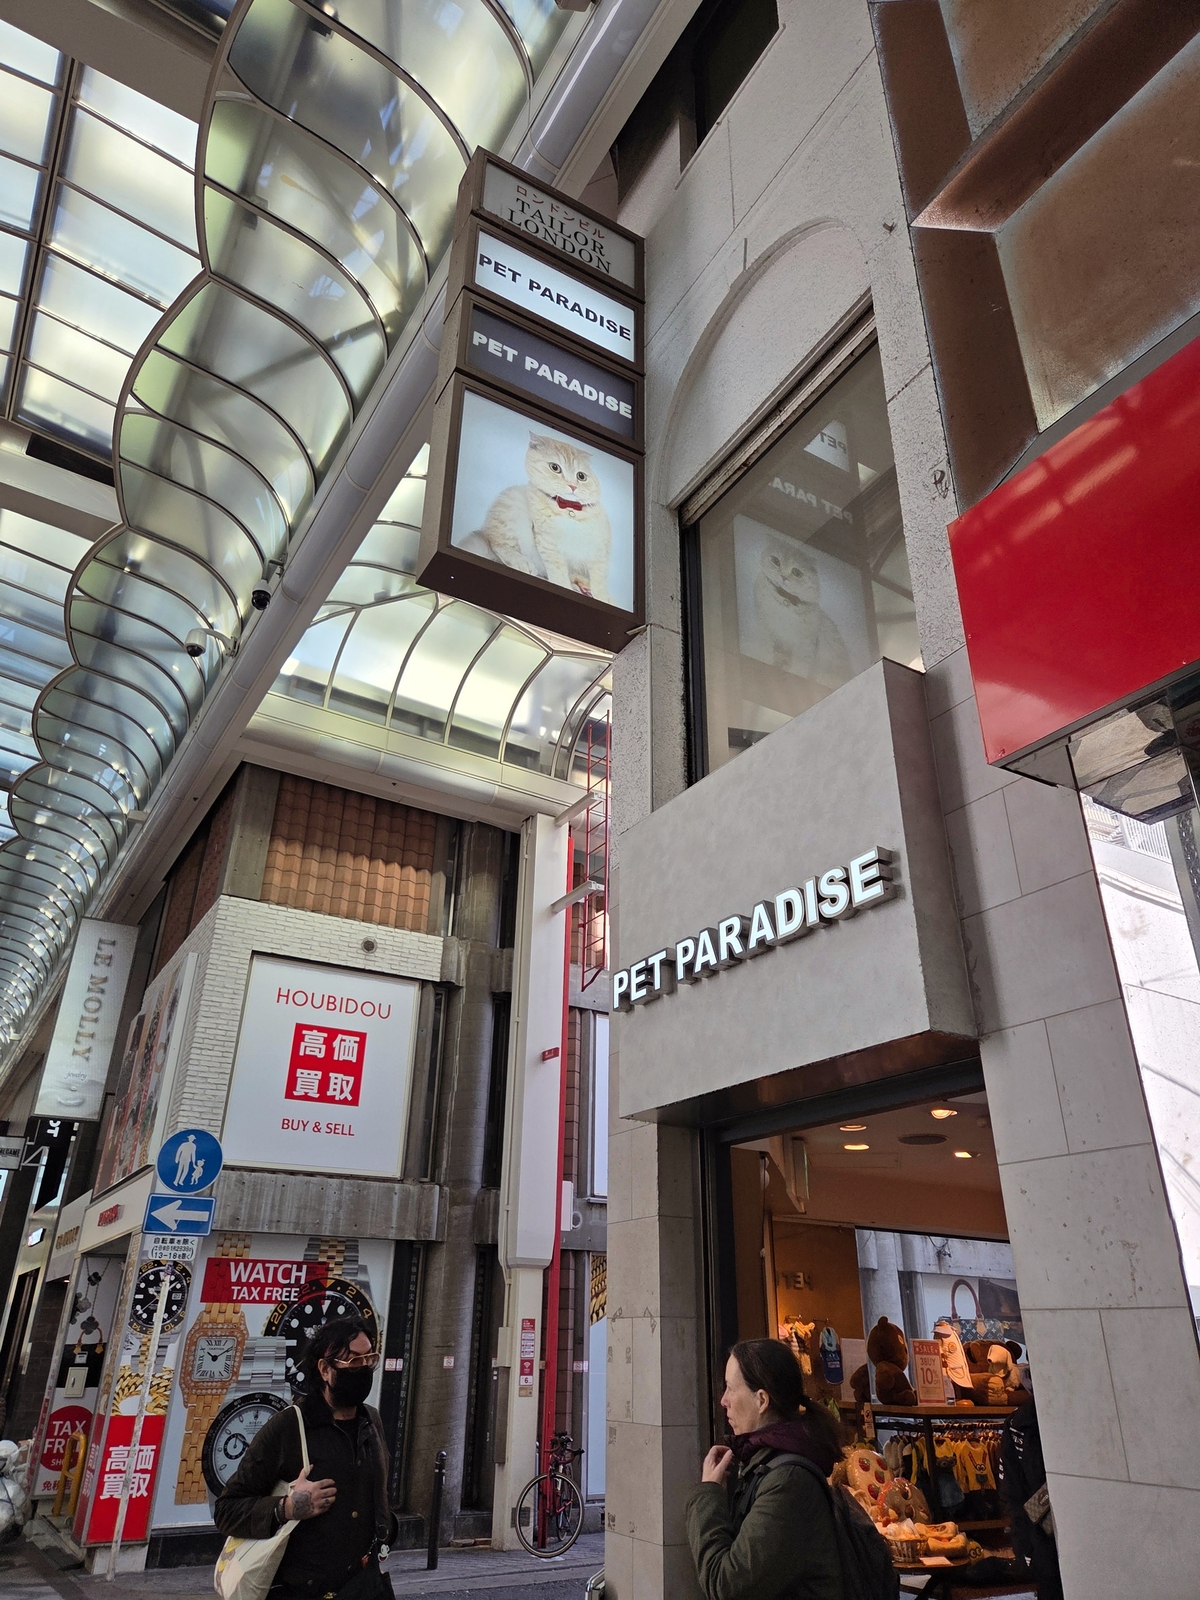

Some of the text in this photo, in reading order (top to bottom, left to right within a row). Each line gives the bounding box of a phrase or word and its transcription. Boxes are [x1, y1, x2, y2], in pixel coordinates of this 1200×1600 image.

[515, 197, 606, 257] TAILOR
[516, 184, 605, 239] ロンドンビル
[507, 208, 612, 274] LONDON
[478, 253, 632, 341] PET PARADISE
[472, 330, 633, 419] PET PARADISE
[612, 845, 893, 1012] PET PARADISE
[72, 937, 116, 1062] LE MOLLY
[276, 987, 392, 1020] HOUBIDOU
[298, 1029, 360, 1063] 高価
[292, 1068, 355, 1101] 買取
[281, 1118, 355, 1137] BUY & SELL
[229, 1261, 308, 1285] WATCH
[231, 1286, 300, 1302] TAX FREE
[920, 1345, 935, 1353] SALE
[52, 1420, 87, 1436] TAX
[43, 1438, 82, 1454] FR
[105, 1444, 157, 1472] 高価
[100, 1472, 151, 1500] 買取
